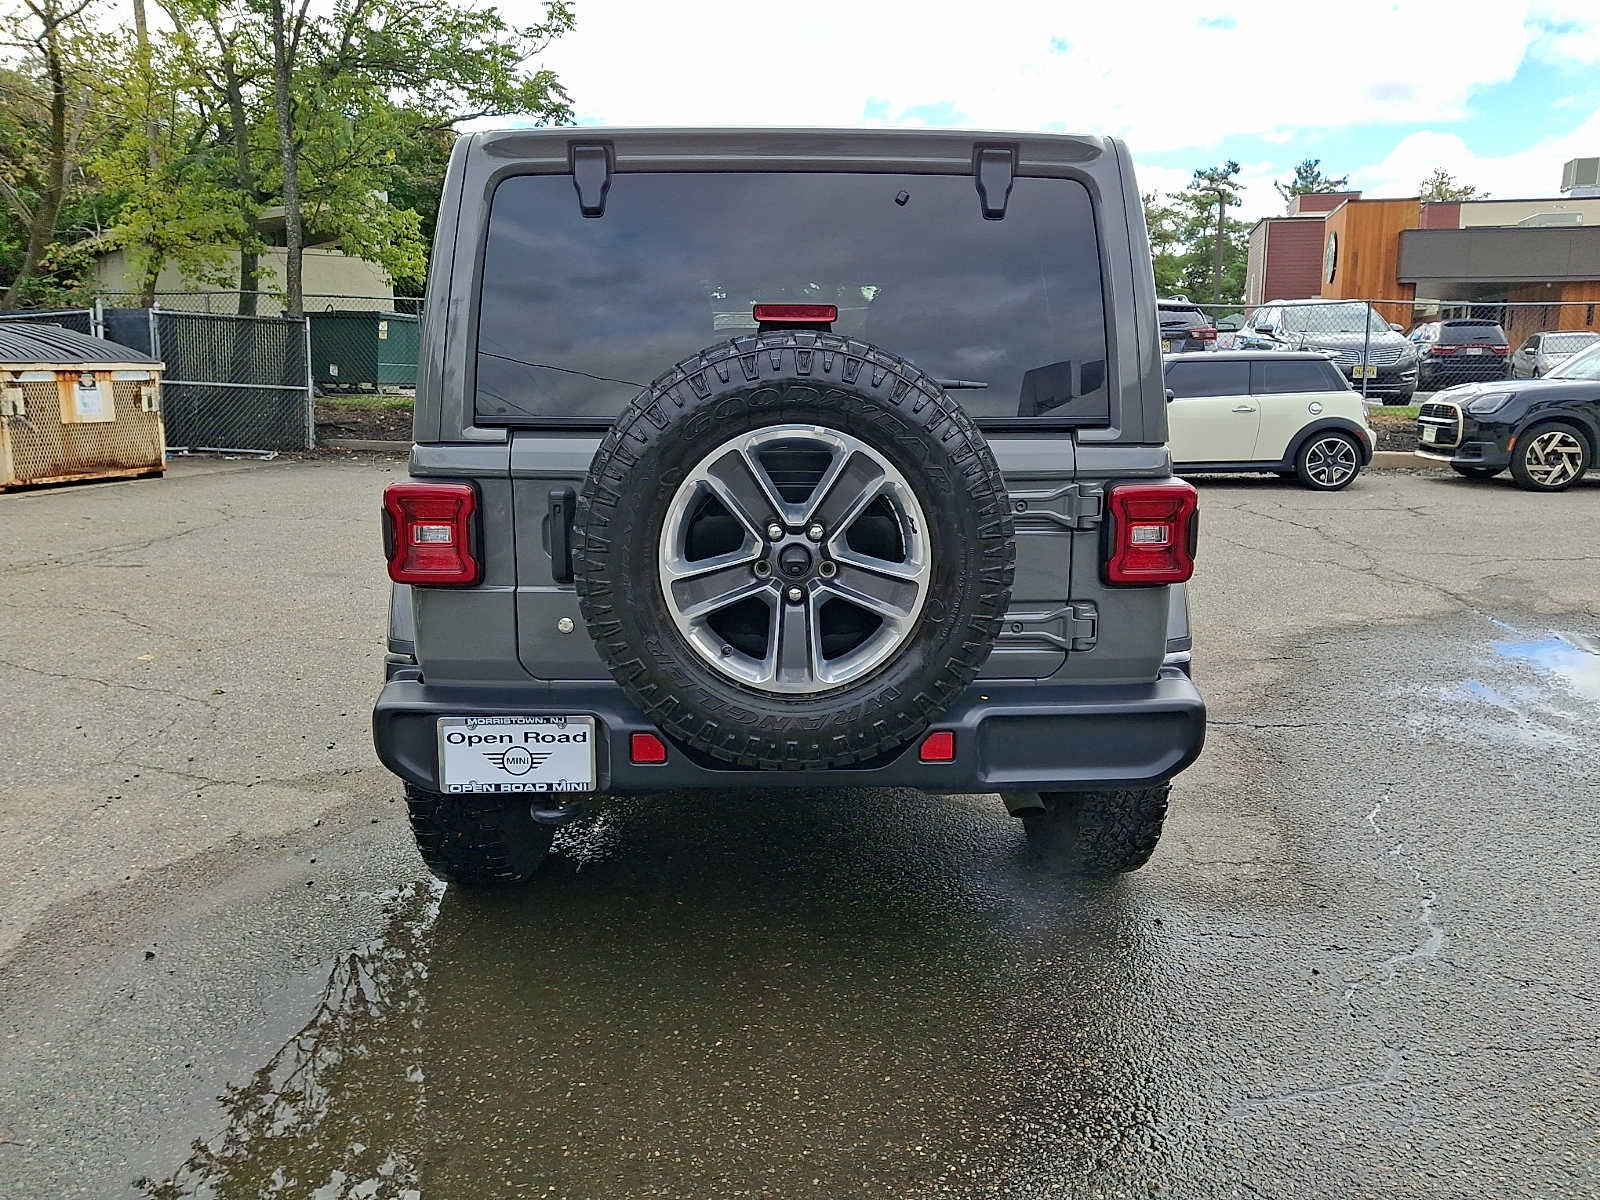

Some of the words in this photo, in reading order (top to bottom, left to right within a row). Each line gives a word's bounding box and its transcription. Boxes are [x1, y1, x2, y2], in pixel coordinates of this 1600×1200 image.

[680, 385, 954, 496] GOODYEAR
[550, 716, 566, 725] NJ
[446, 731, 513, 748] Open
[523, 731, 587, 744] Road
[506, 757, 529, 765] MINI
[449, 784, 495, 793] OPEN
[500, 783, 547, 792] ROAD
[552, 783, 587, 792] MINI
